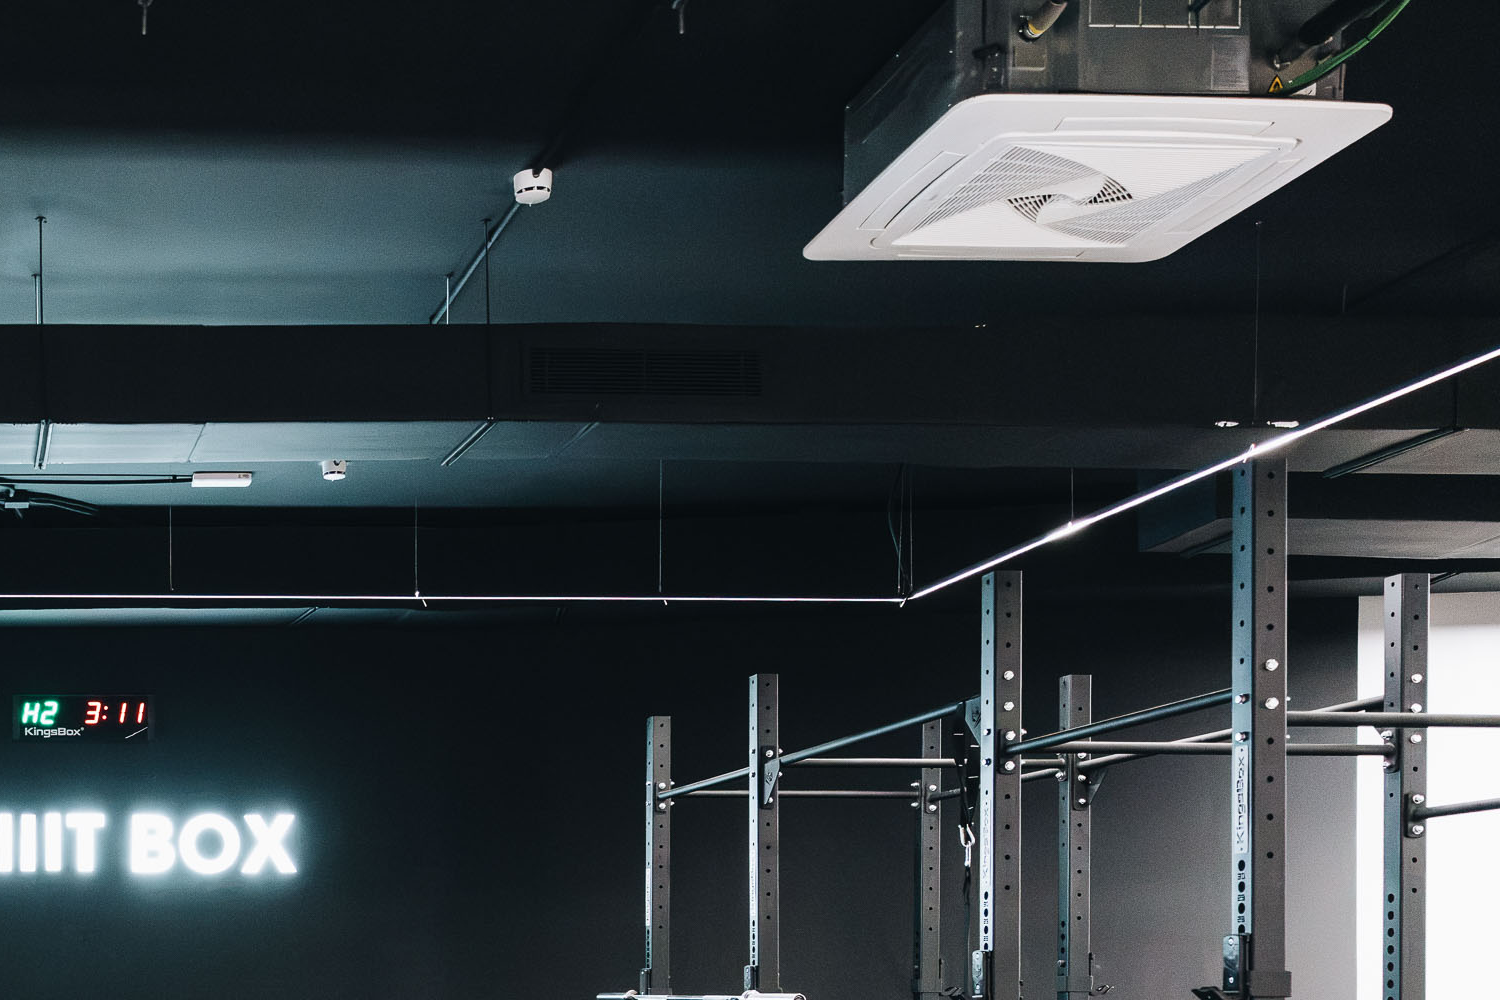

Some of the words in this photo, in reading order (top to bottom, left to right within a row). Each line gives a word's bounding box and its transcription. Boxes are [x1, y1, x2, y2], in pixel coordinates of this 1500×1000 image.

[21, 701, 59, 725] H2
[84, 701, 145, 724] 3:11
[24, 727, 82, 738] KingsBox
[130, 812, 298, 874] BOX
